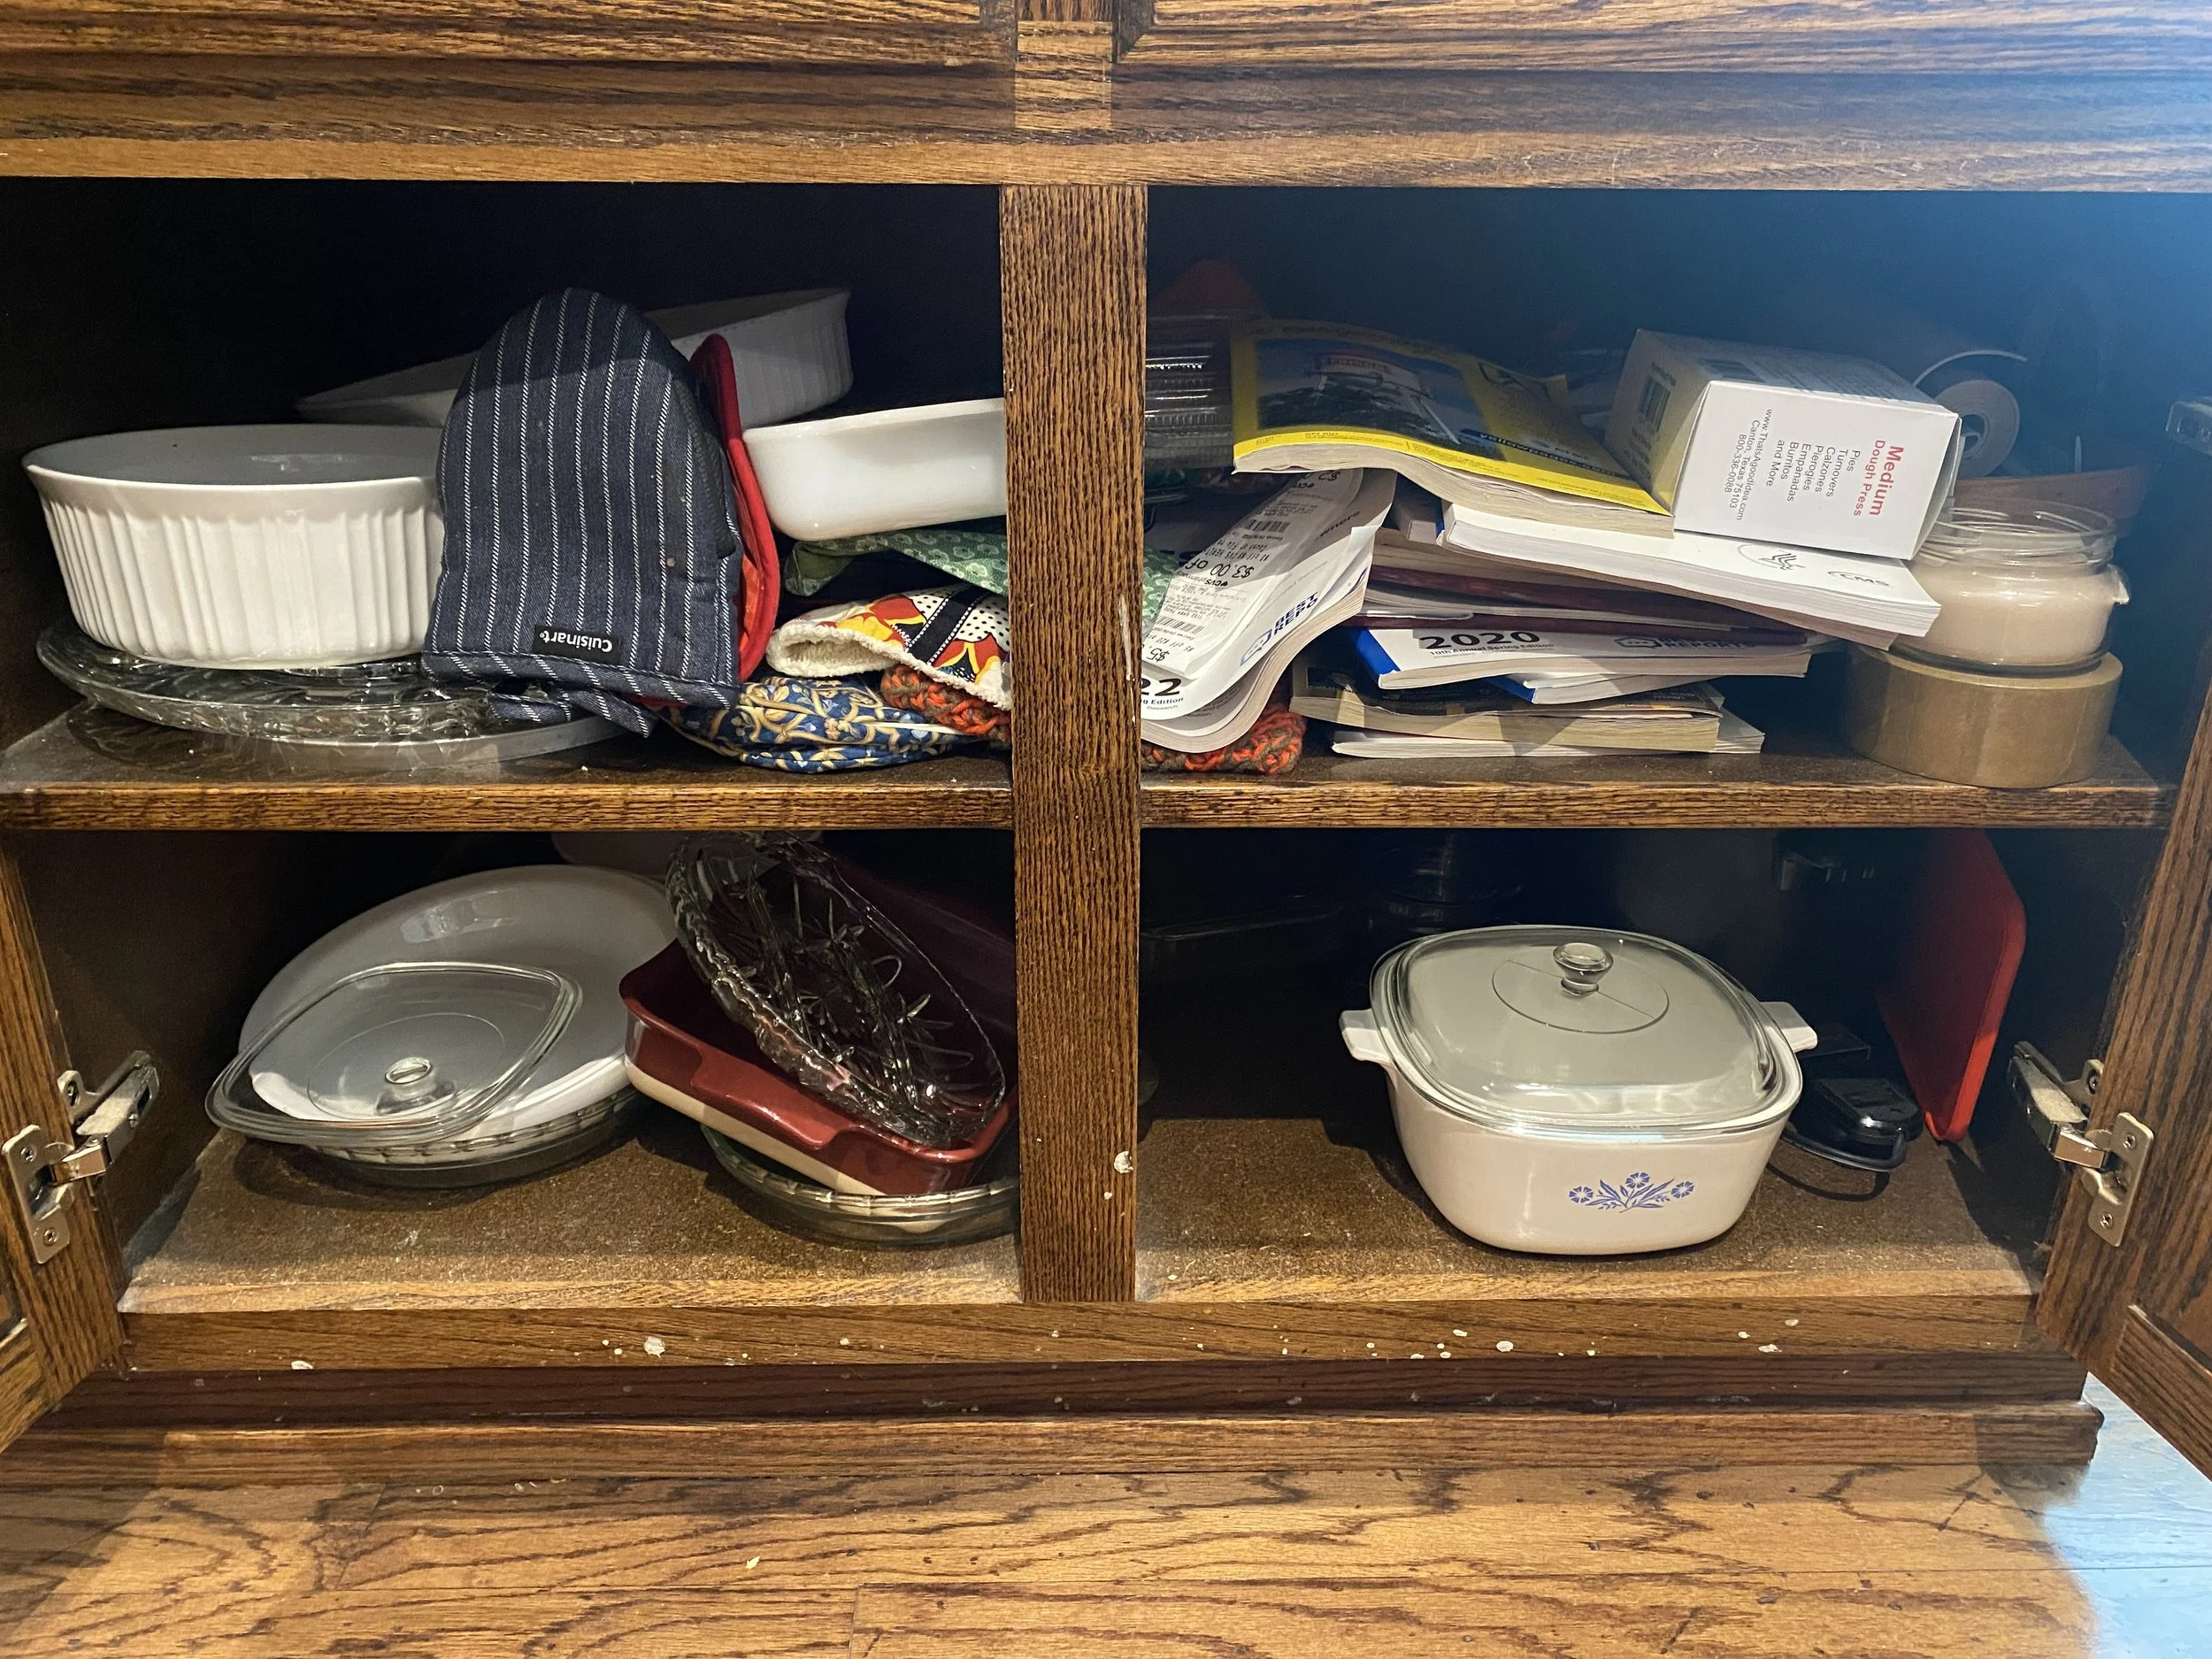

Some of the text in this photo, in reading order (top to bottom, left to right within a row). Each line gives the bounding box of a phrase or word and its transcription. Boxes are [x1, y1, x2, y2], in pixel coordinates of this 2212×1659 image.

[1722, 434, 1747, 495] 800-336-0088
[1729, 419, 1761, 510] Canton, Texas 75103
[1735, 409, 1773, 522] www.ThatsAgoodIdea.com
[1765, 440, 1786, 487] and More
[1780, 442, 1800, 480] Burritos
[1786, 443, 1812, 503] Empanadas
[1802, 444, 1824, 492] Pierogies
[1815, 447, 1836, 493] Calzones
[1825, 449, 1849, 497] Turnovers
[1847, 449, 1861, 472] Pies
[1853, 440, 1886, 517] Dough Press
[1869, 444, 1906, 517] Medium
[1184, 558, 1255, 580] $3.00 of
[1839, 572, 1890, 587] CMS
[1274, 598, 1318, 635] REPO
[1275, 592, 1318, 627] BEST
[1141, 643, 1170, 662] $5.
[1419, 632, 1540, 649] 2020
[1141, 678, 1181, 696] 22
